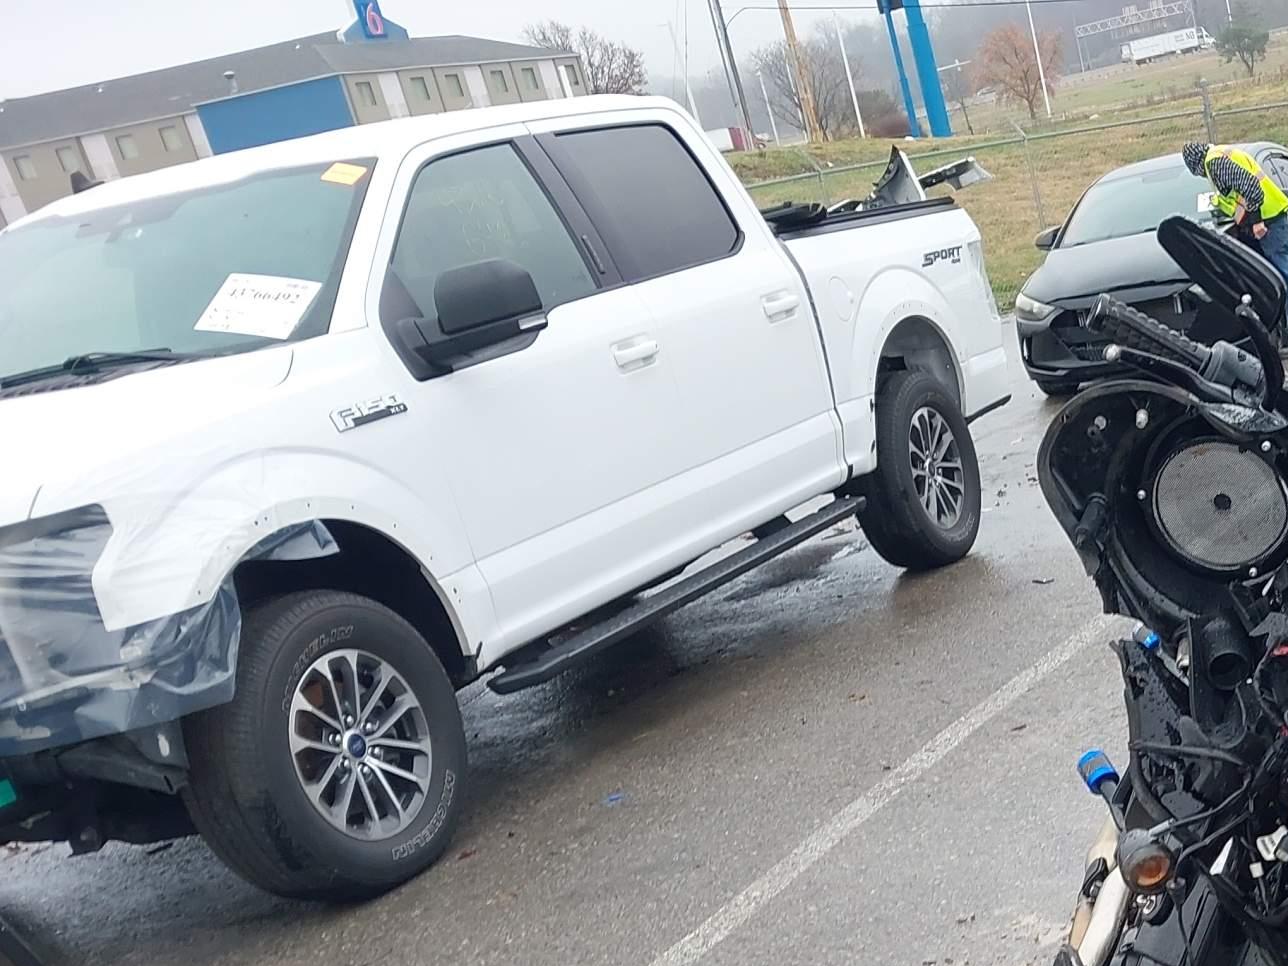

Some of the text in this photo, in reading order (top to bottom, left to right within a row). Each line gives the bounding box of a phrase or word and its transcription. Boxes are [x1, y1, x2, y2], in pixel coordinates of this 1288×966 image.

[366, 2, 384, 36] 6
[921, 244, 963, 268] SPORT
[391, 768, 456, 861] MICHELIN
